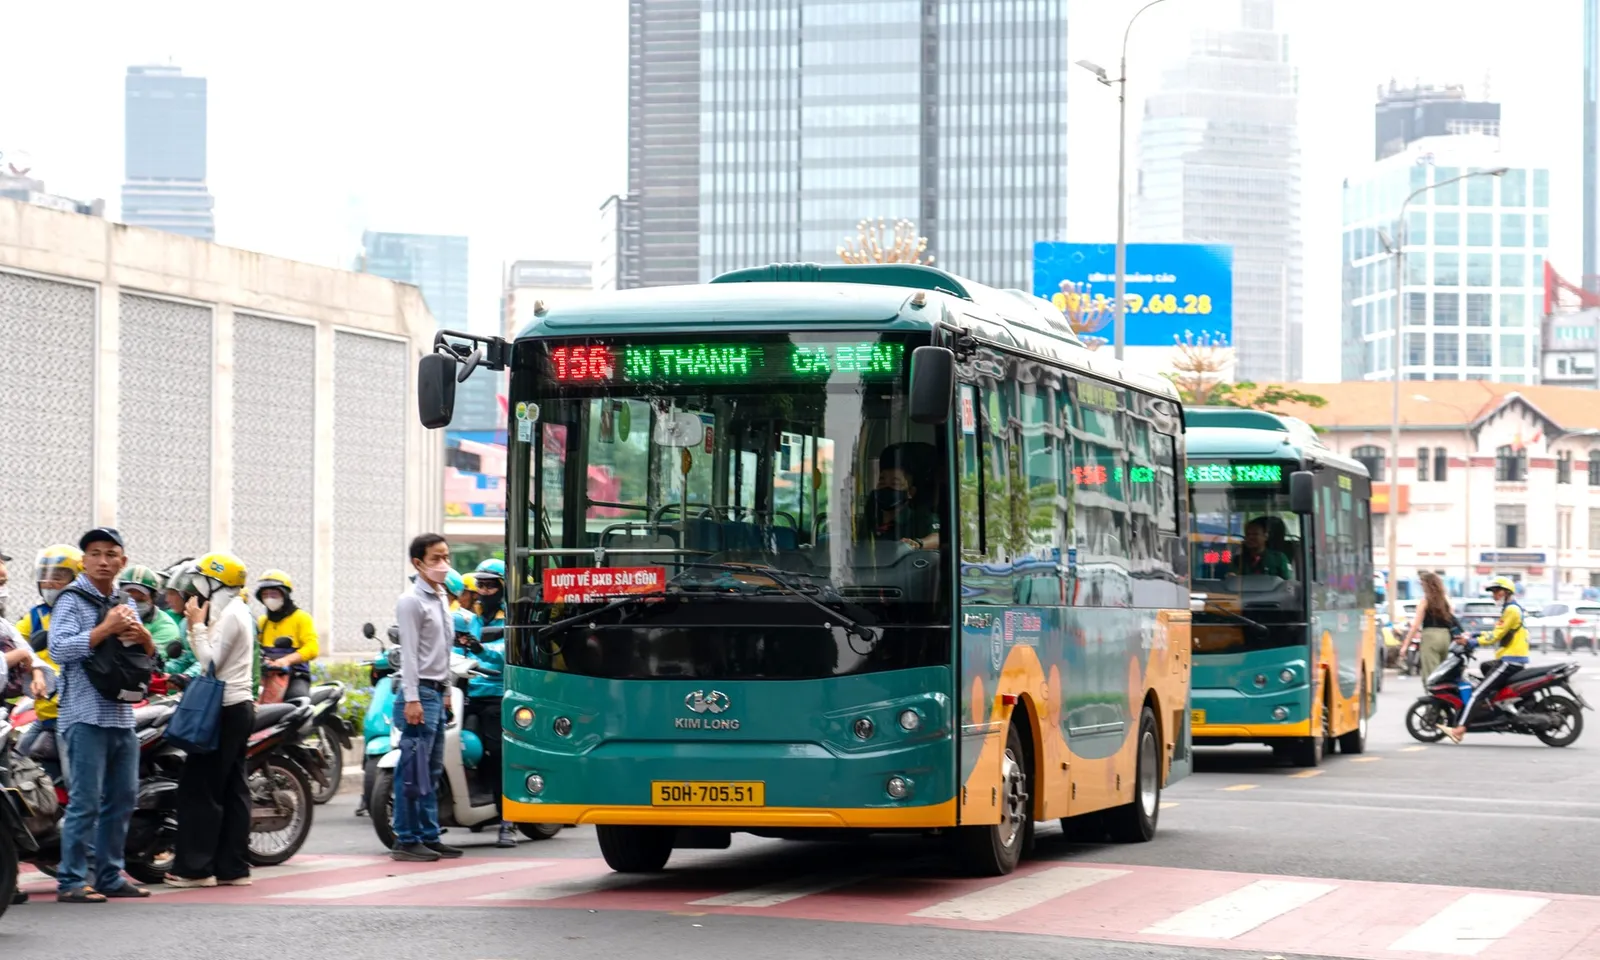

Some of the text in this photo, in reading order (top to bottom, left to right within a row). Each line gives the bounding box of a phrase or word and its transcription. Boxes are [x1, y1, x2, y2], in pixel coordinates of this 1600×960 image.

[553, 347, 608, 379] 156
[793, 346, 830, 373] GA
[551, 569, 657, 589] LƯỢT VỀ BXB SÀI GÒN
[675, 718, 740, 730] KIM LONG
[661, 786, 753, 802] 50H-705.51
